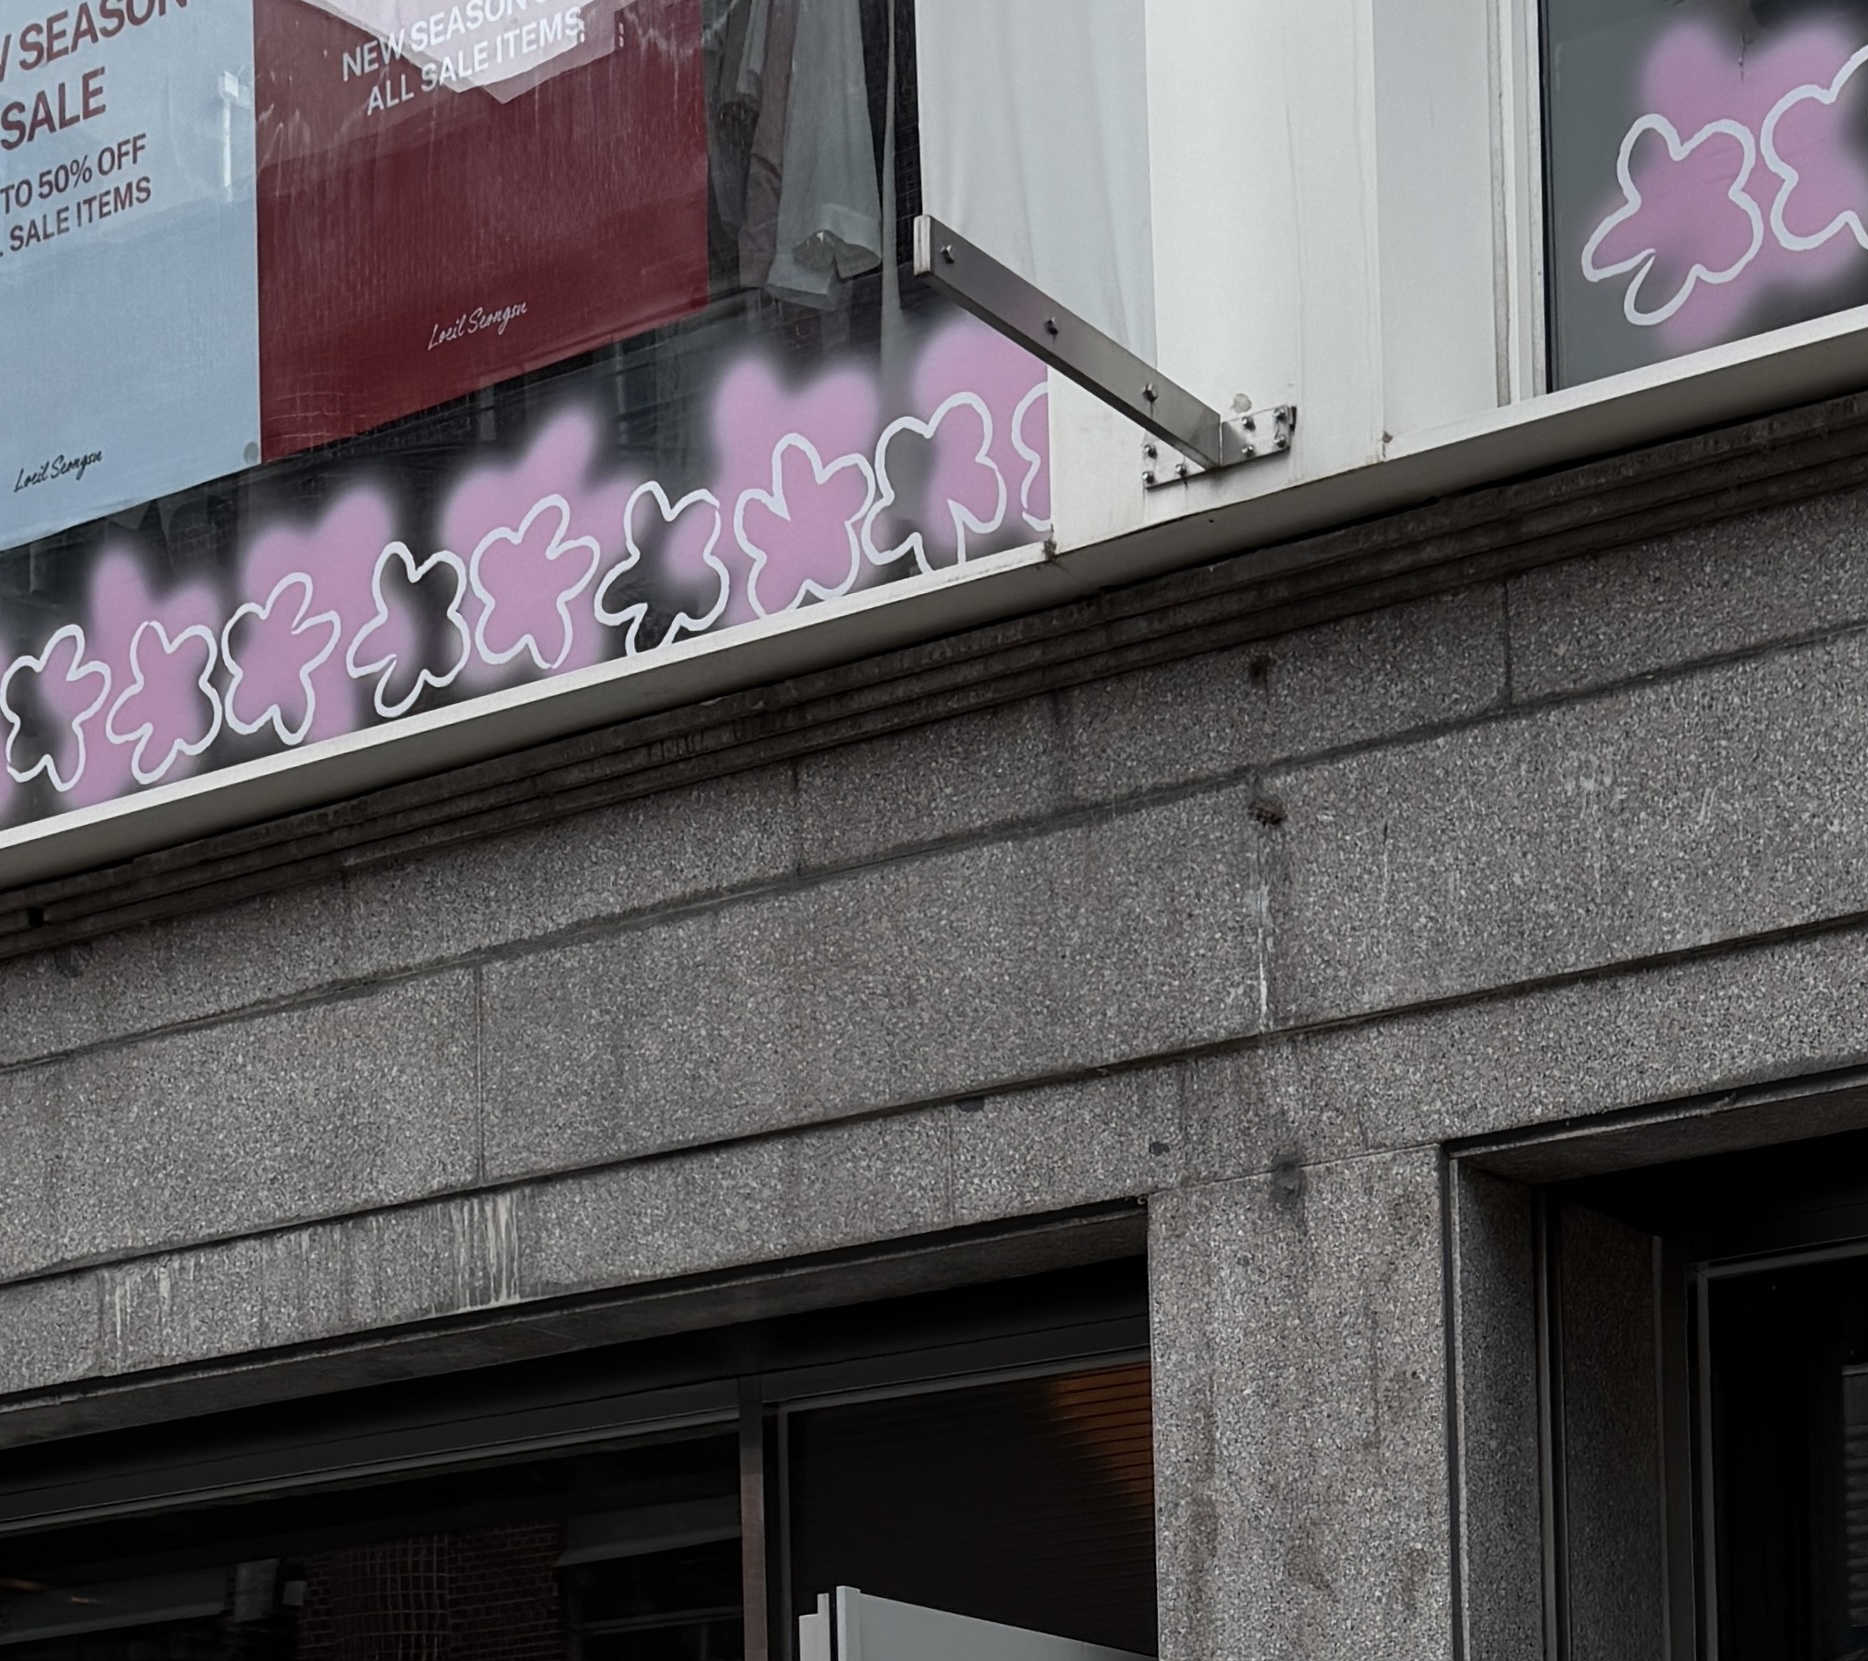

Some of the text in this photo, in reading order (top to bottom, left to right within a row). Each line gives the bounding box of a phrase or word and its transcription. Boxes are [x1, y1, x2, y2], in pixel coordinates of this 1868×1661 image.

[342, 28, 404, 82] NEW
[367, 6, 584, 116] ALL SALE ITEMS
[1, 66, 106, 150] SALE
[0, 133, 146, 214] TO 50% OFF
[9, 176, 151, 252] SALE ITEMS
